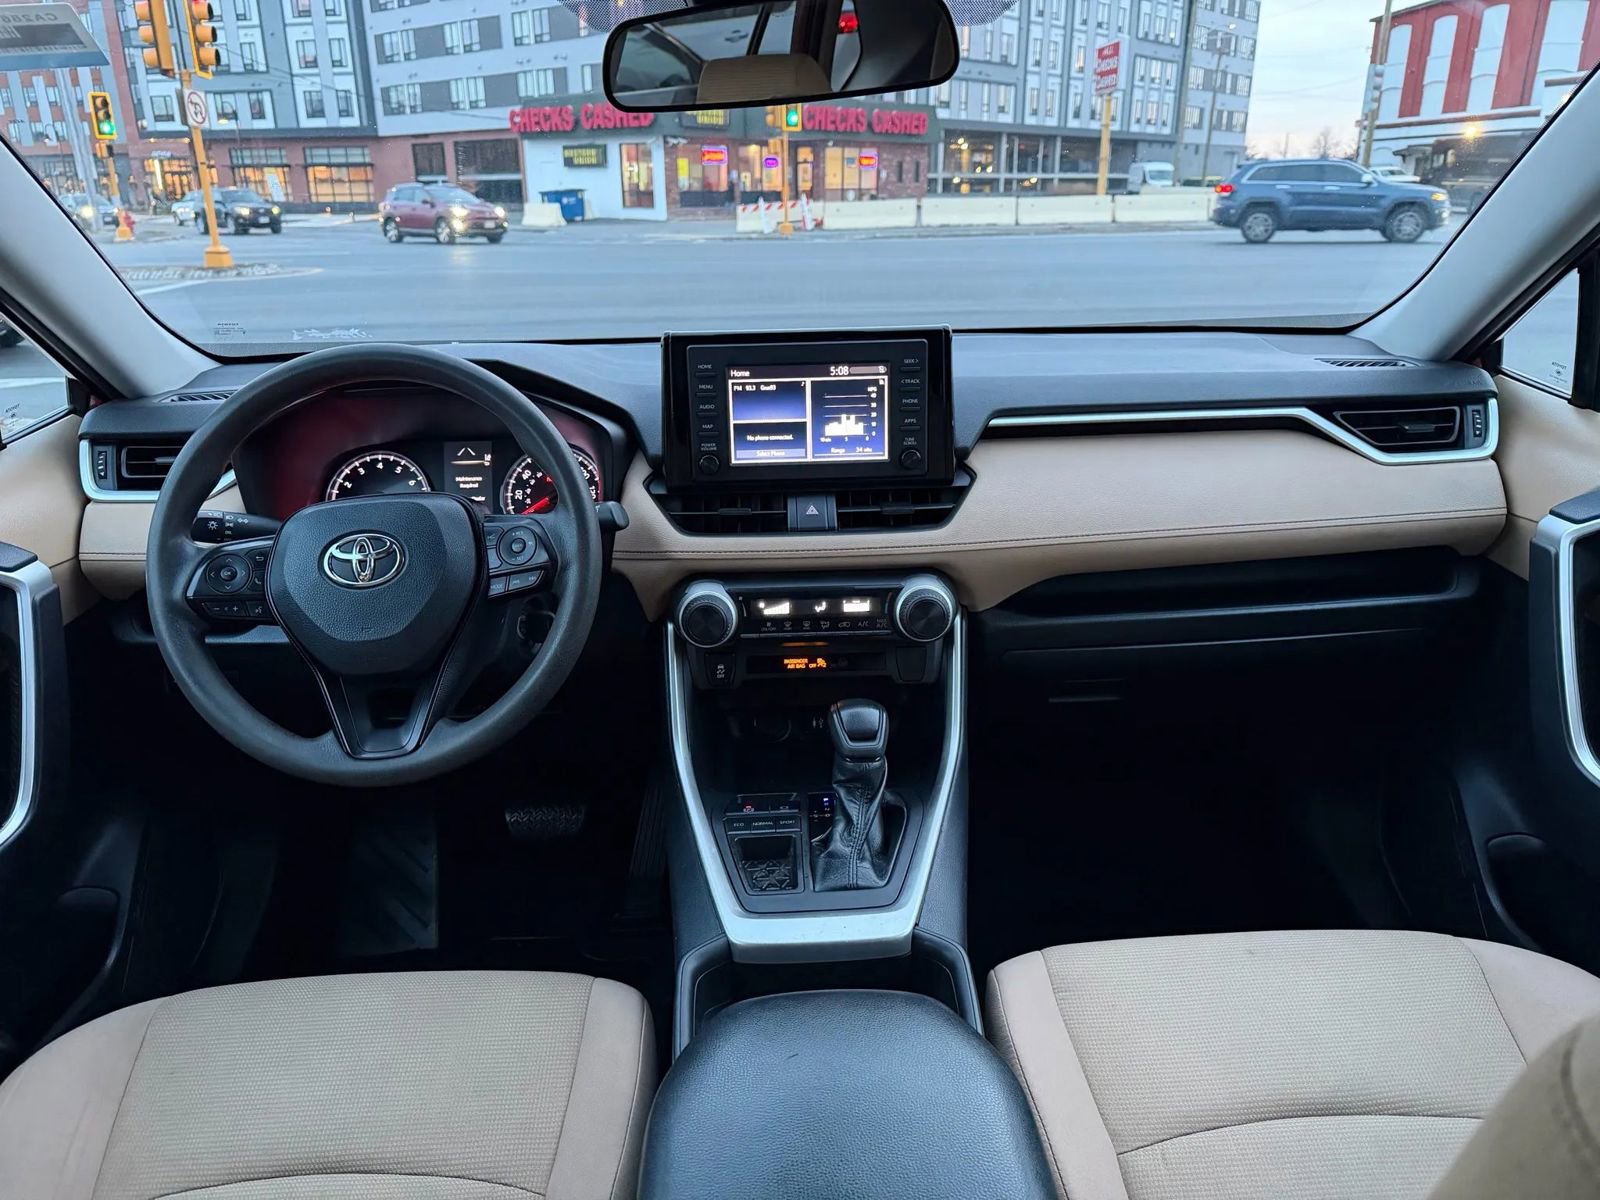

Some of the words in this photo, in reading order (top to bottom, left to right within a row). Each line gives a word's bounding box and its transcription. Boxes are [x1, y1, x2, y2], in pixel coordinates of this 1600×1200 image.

[509, 105, 574, 133] CHECKS
[580, 102, 655, 129] CASHED
[802, 104, 868, 132] CHECKS
[872, 108, 928, 135] CASHED
[830, 366, 849, 376] 5:08
[358, 467, 365, 475] 3
[522, 469, 532, 480] 40
[343, 481, 352, 489] 2
[515, 489, 523, 500] 20
